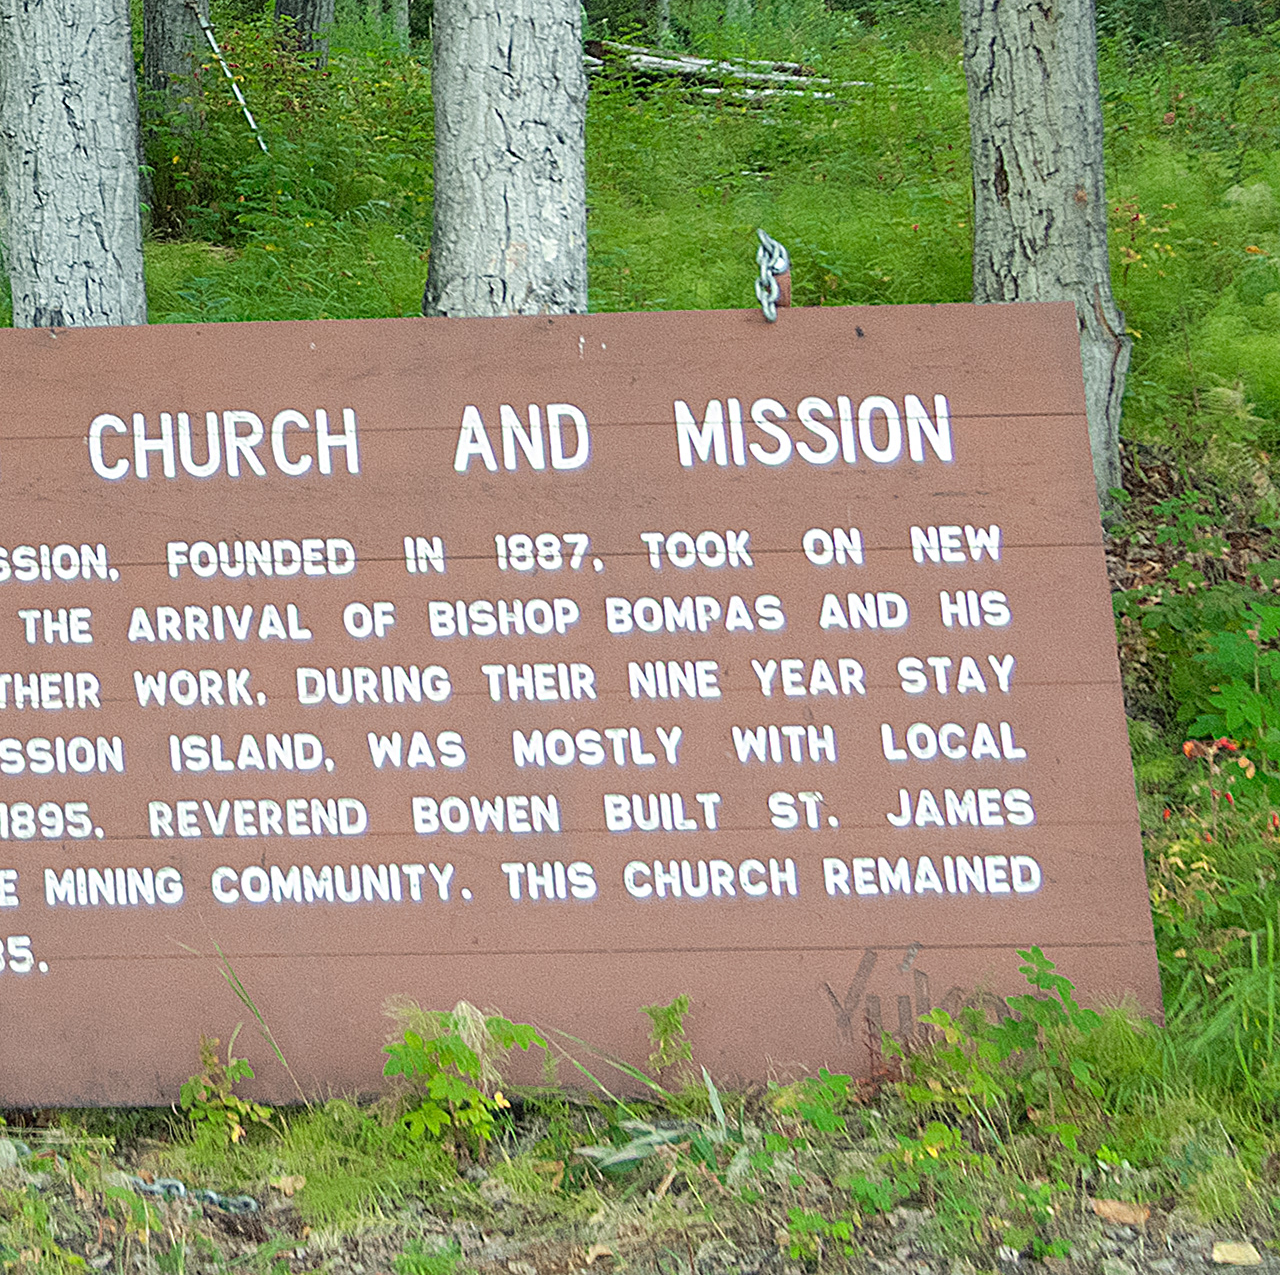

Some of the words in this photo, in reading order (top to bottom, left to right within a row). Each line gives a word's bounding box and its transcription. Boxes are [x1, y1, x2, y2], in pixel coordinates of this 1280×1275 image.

[88, 407, 360, 480] CHURCH
[453, 403, 590, 474] AND
[673, 394, 953, 470] MISSION
[167, 538, 356, 578] FOUNDED
[403, 536, 447, 576] IN
[640, 529, 754, 571] TOOK
[802, 527, 865, 568] ON
[910, 524, 1000, 565] NEW
[17, 607, 94, 645] THE
[127, 603, 313, 643] ARRIVAL
[343, 601, 395, 641] OF
[428, 598, 580, 639] BISHOP
[605, 594, 786, 635] BOMPAS
[819, 591, 909, 632] AND
[939, 589, 1011, 632] HIS
[296, 664, 452, 707] DURING
[480, 662, 598, 704] THEIR
[627, 660, 723, 703] NINE
[751, 658, 866, 699] YEAR
[897, 653, 1015, 699] STAY
[367, 730, 466, 774] WAS
[512, 725, 683, 769] MOSTLY
[731, 724, 837, 768] WITH
[880, 721, 1027, 764] LOCAL
[148, 797, 368, 839] REVEREND
[411, 794, 561, 834] BOWEN
[603, 792, 722, 832] BUILT
[768, 790, 839, 829] ST.
[886, 788, 1035, 830] JAMES
[44, 866, 184, 908] MINING
[500, 860, 598, 903] THIS
[623, 857, 798, 903] CHURCH
[822, 854, 1042, 899] REMAINED
